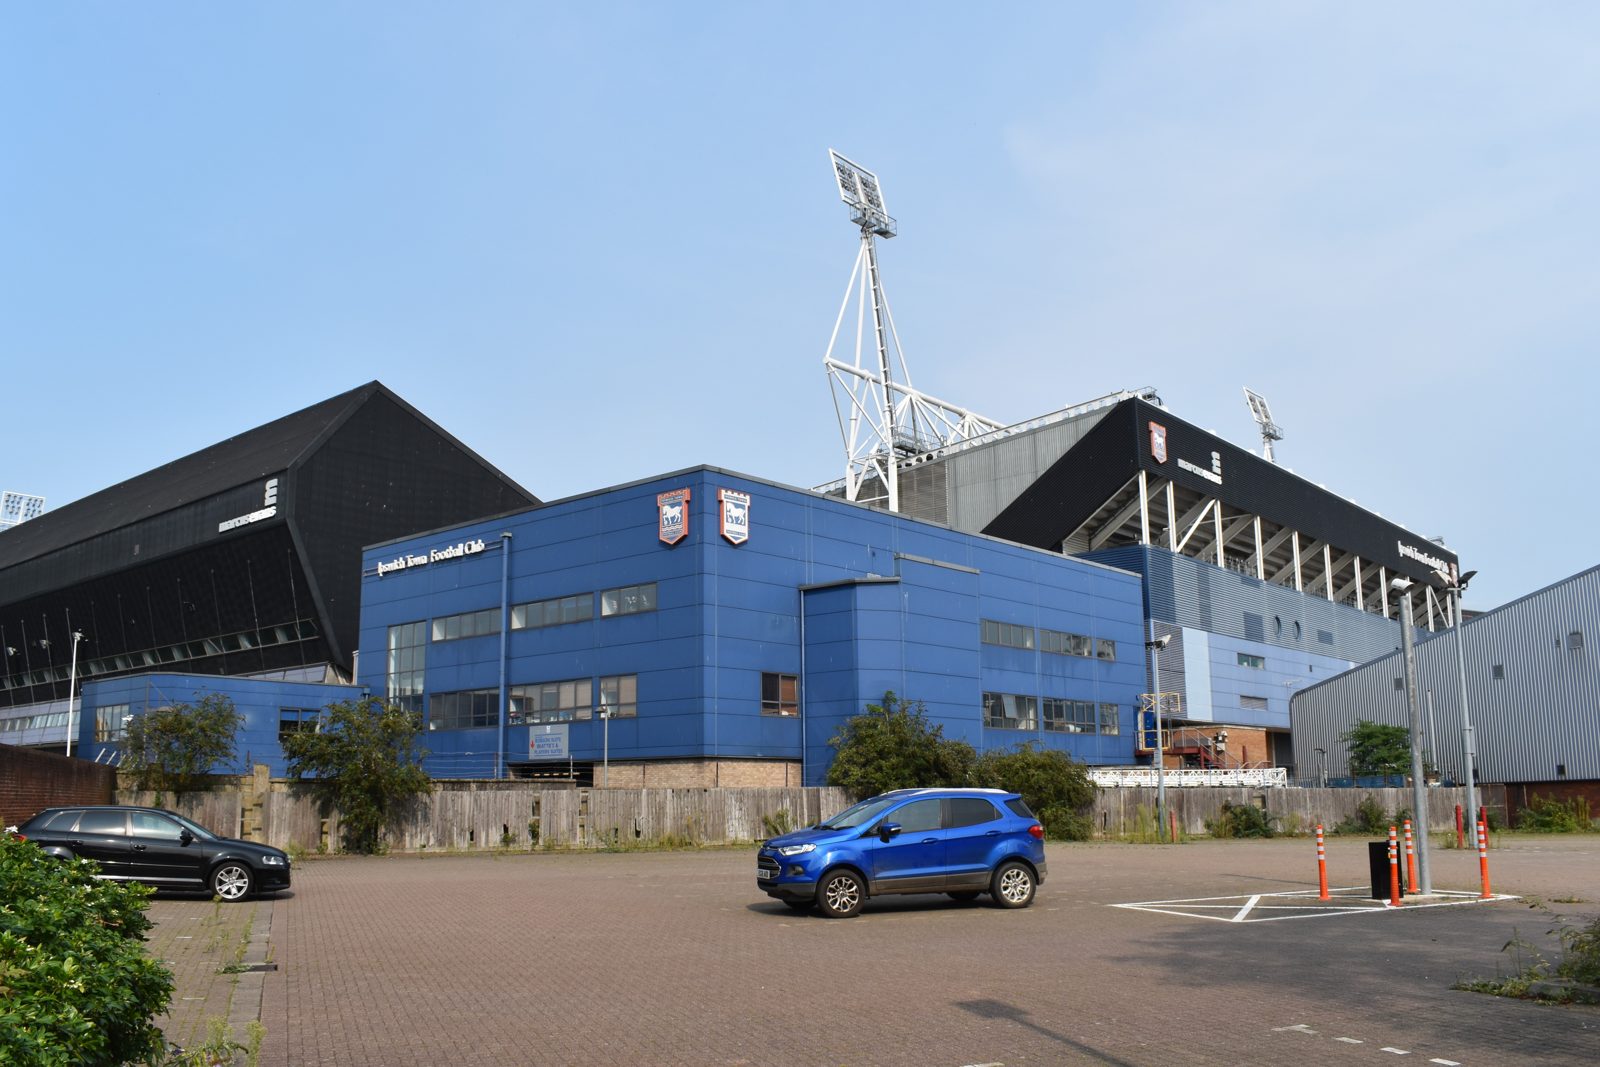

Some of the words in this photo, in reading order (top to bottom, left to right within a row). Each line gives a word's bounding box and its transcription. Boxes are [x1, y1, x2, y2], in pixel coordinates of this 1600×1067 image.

[377, 557, 406, 577] Ipswich
[405, 554, 428, 567] Town
[430, 543, 464, 562] Football
[464, 539, 485, 554] Club
